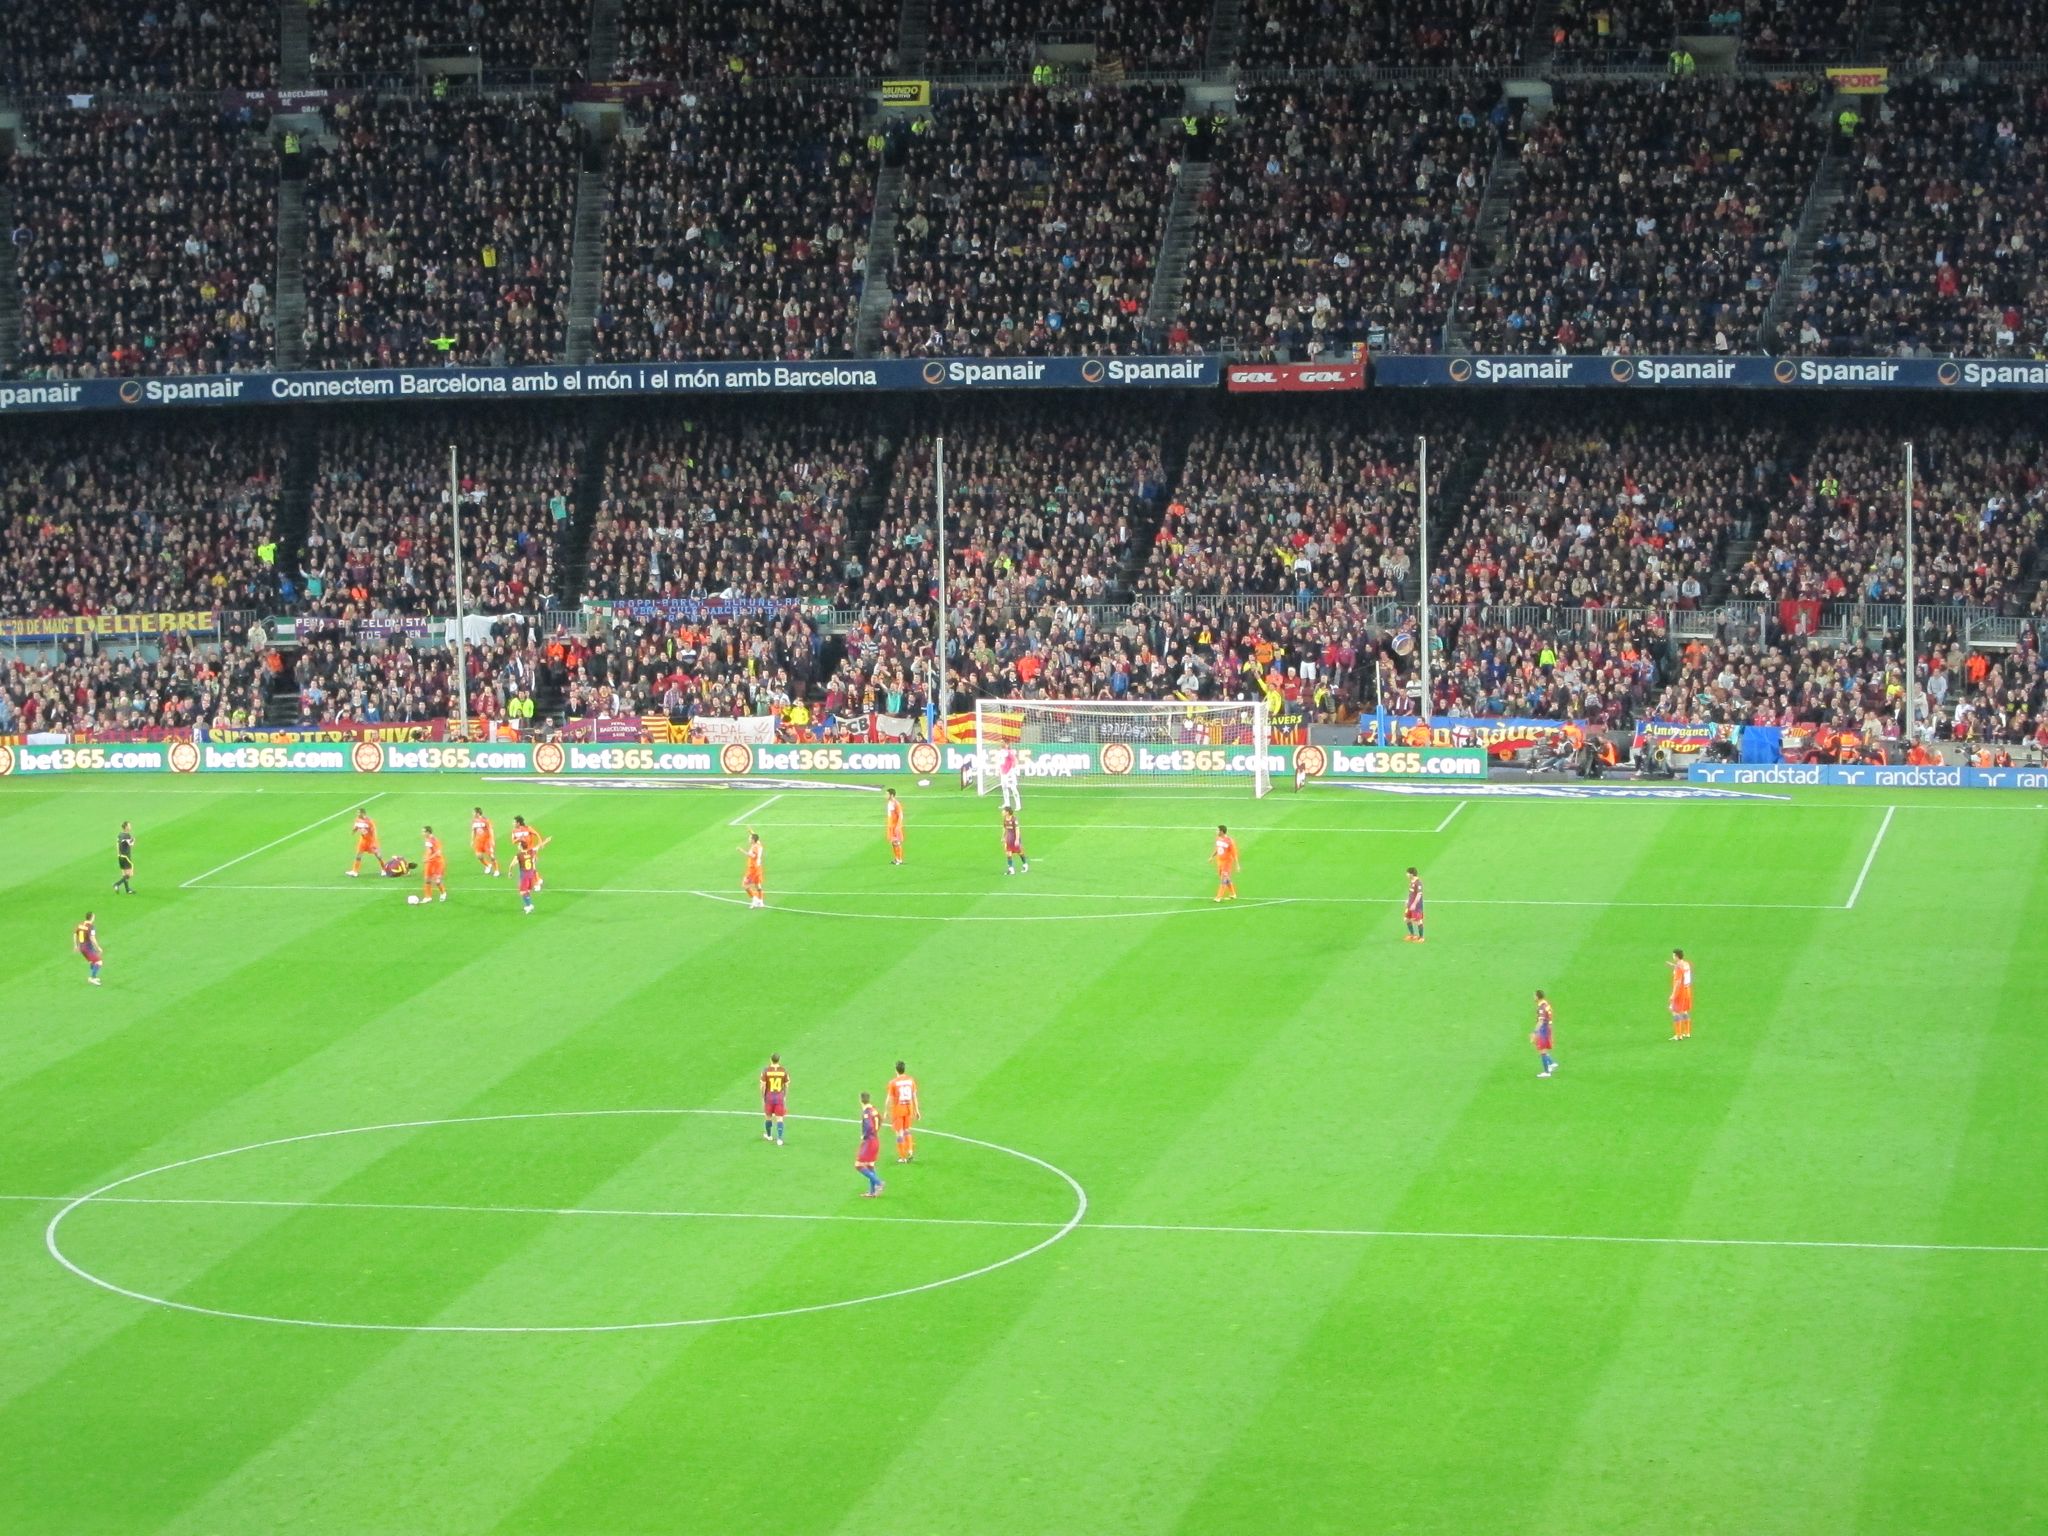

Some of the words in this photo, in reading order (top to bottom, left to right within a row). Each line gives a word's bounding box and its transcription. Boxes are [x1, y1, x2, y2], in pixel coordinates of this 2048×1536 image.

[271, 377, 394, 398] Connectem
[400, 373, 507, 394] Barcelona
[511, 372, 558, 392] amb
[563, 371, 581, 389] el
[588, 370, 632, 389] món
[639, 370, 645, 388] i
[651, 370, 668, 388] el
[675, 369, 719, 388] món
[725, 368, 771, 387] amb
[774, 367, 877, 386] Barcelona
[949, 361, 1046, 384] Spanair
[1108, 360, 1204, 383] Spanair
[1475, 359, 1573, 383] Spanair
[1637, 359, 1736, 383] Spanair
[1800, 361, 1899, 384] Spanair
[146, 378, 243, 403] Spanair
[75, 611, 213, 635] DELTEBRE
[20, 749, 161, 770] bet365.com
[206, 747, 343, 768] bet365.com
[389, 747, 526, 768] bet365.com
[571, 748, 711, 769] bet365.com
[758, 748, 901, 770] bet365.com
[1333, 751, 1481, 774] bet365.com
[1734, 765, 1820, 784] randstad
[1875, 767, 1961, 786] randstad
[769, 1078, 782, 1092] 14
